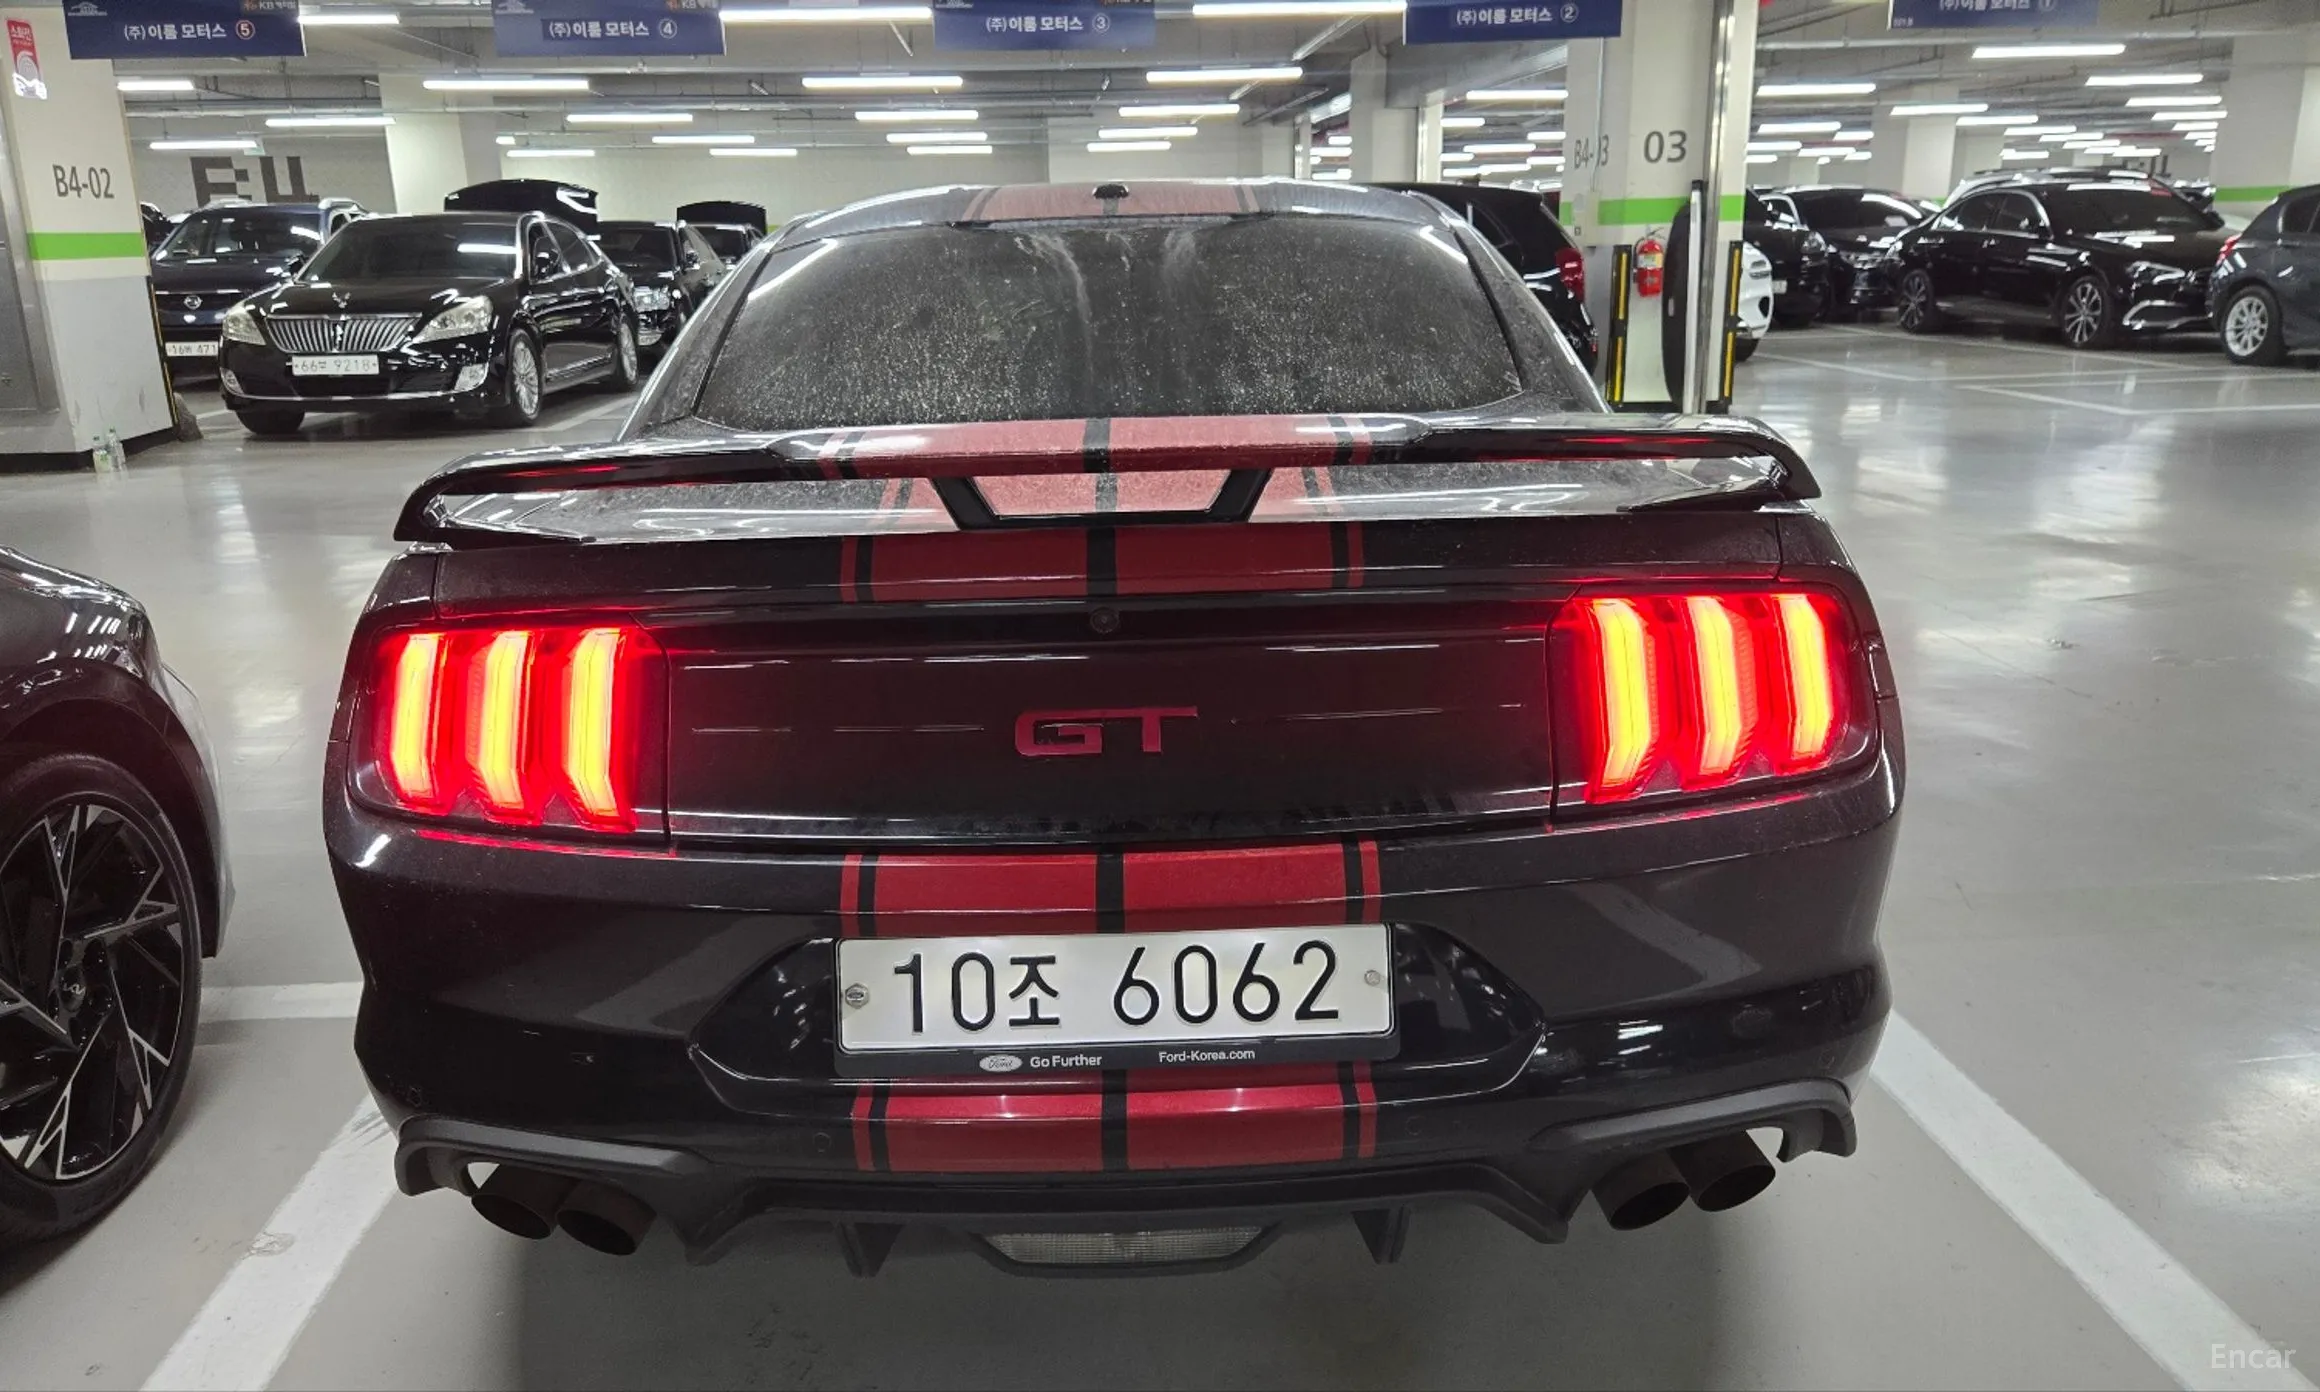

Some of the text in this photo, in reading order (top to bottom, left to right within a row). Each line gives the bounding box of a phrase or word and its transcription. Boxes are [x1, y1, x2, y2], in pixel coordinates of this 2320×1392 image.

[1039, 15, 1084, 32] 모터스
[1510, 7, 1553, 24] 모터스
[181, 23, 227, 40] 모터스
[604, 20, 650, 38] 모터스
[1643, 130, 1688, 164] 03
[52, 163, 115, 199] B4-02
[1014, 706, 1199, 757] GT
[893, 940, 1340, 1034] 10조 6062
[1030, 1054, 1103, 1068] Go Further
[1159, 1049, 1256, 1064] Ford-Korea.com
